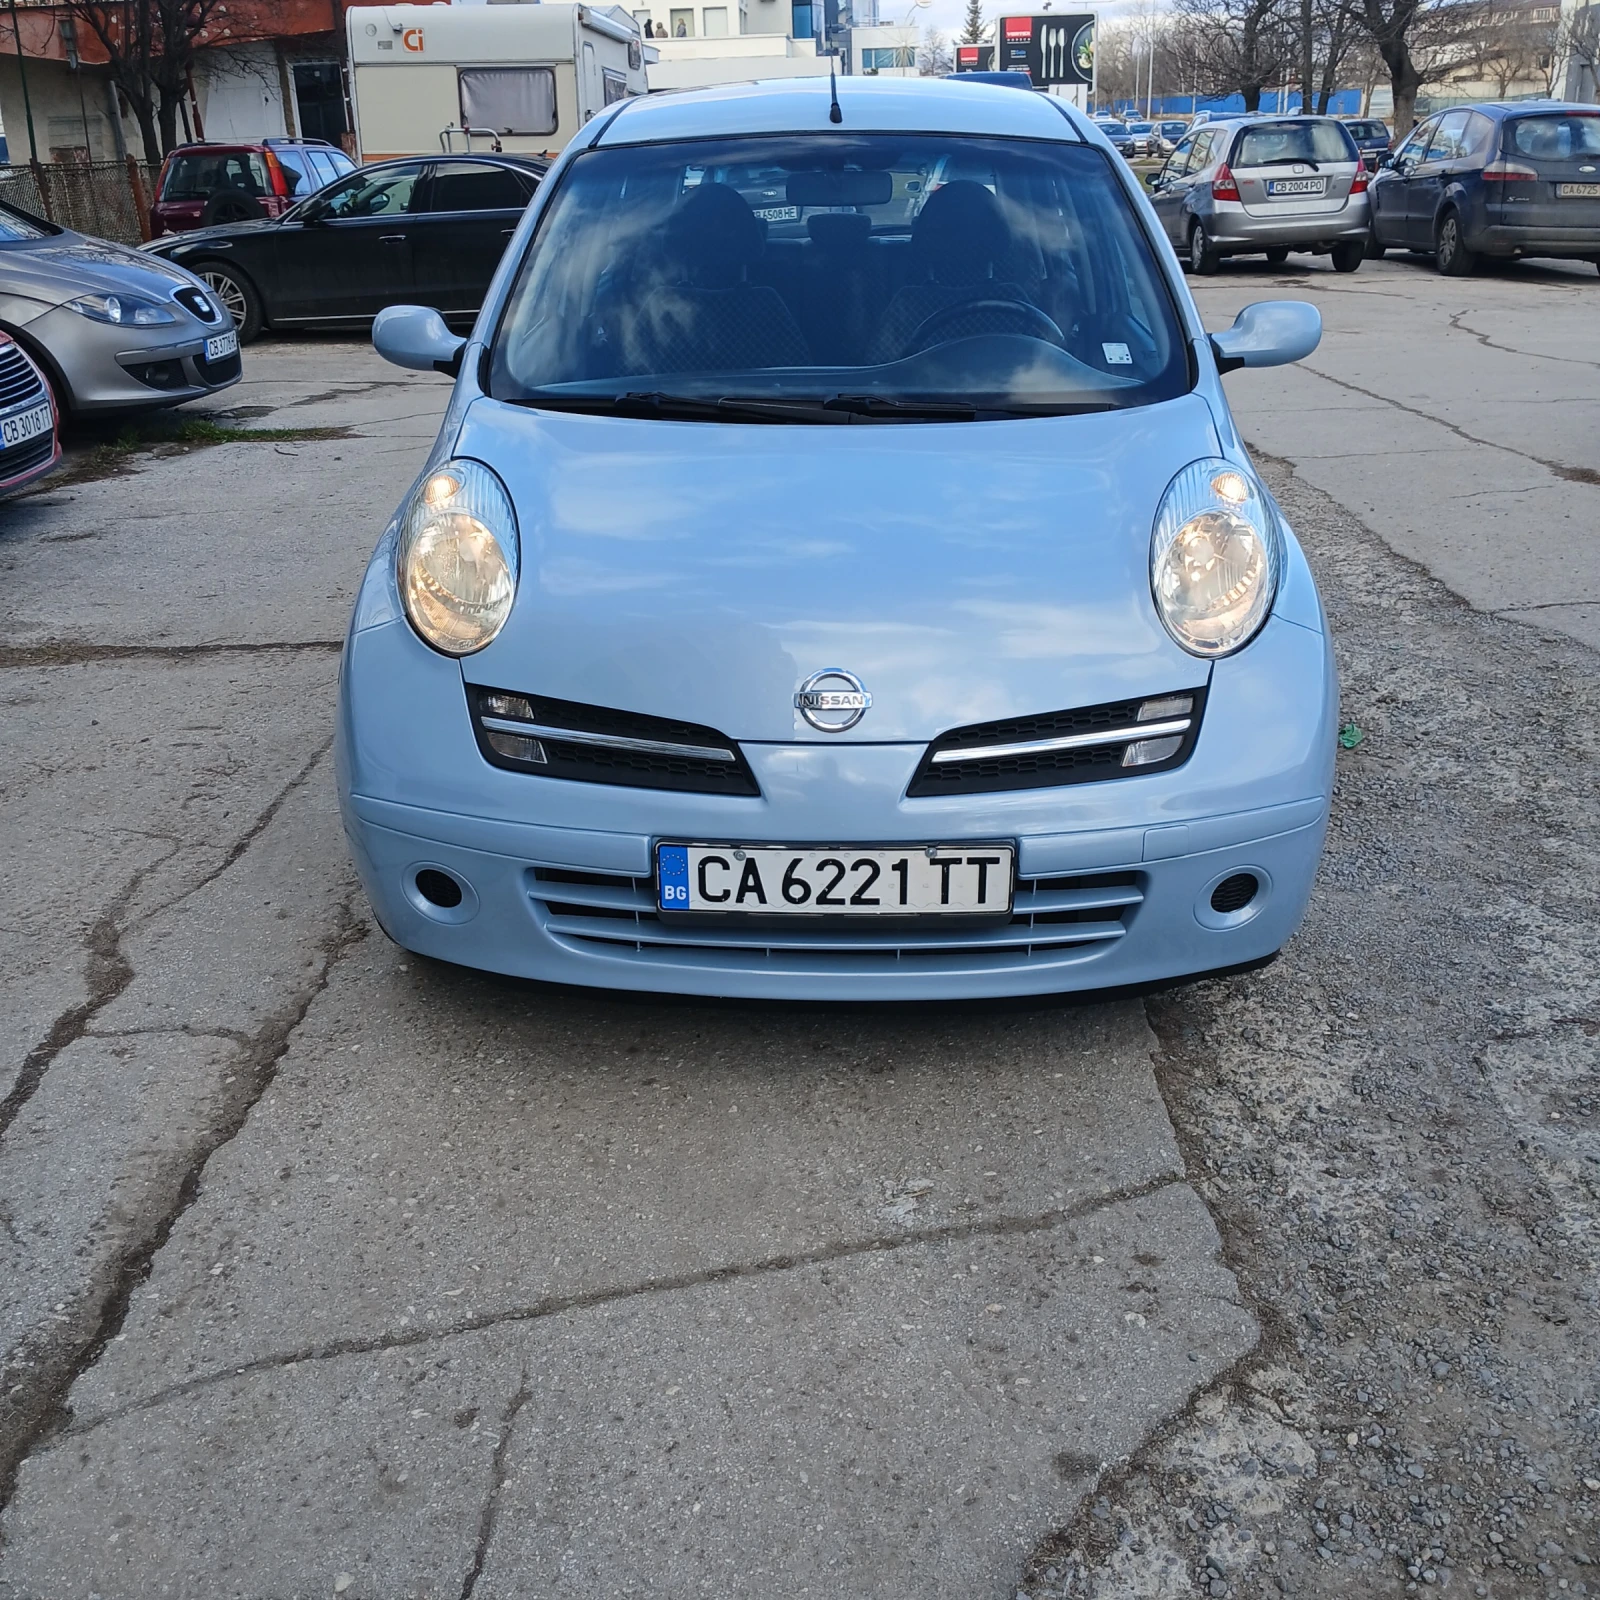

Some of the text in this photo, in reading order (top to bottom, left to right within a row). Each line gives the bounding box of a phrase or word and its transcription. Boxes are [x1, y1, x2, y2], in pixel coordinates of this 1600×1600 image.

[403, 29, 424, 51] Ci
[1288, 181, 1309, 191] 2004
[1562, 185, 1598, 195] CA 6725
[784, 207, 796, 219] HE
[3, 405, 50, 443] CB 3018 TT
[801, 694, 864, 706] NISSAN
[698, 855, 1001, 906] CA 6221 TT
[664, 886, 686, 900] BG
